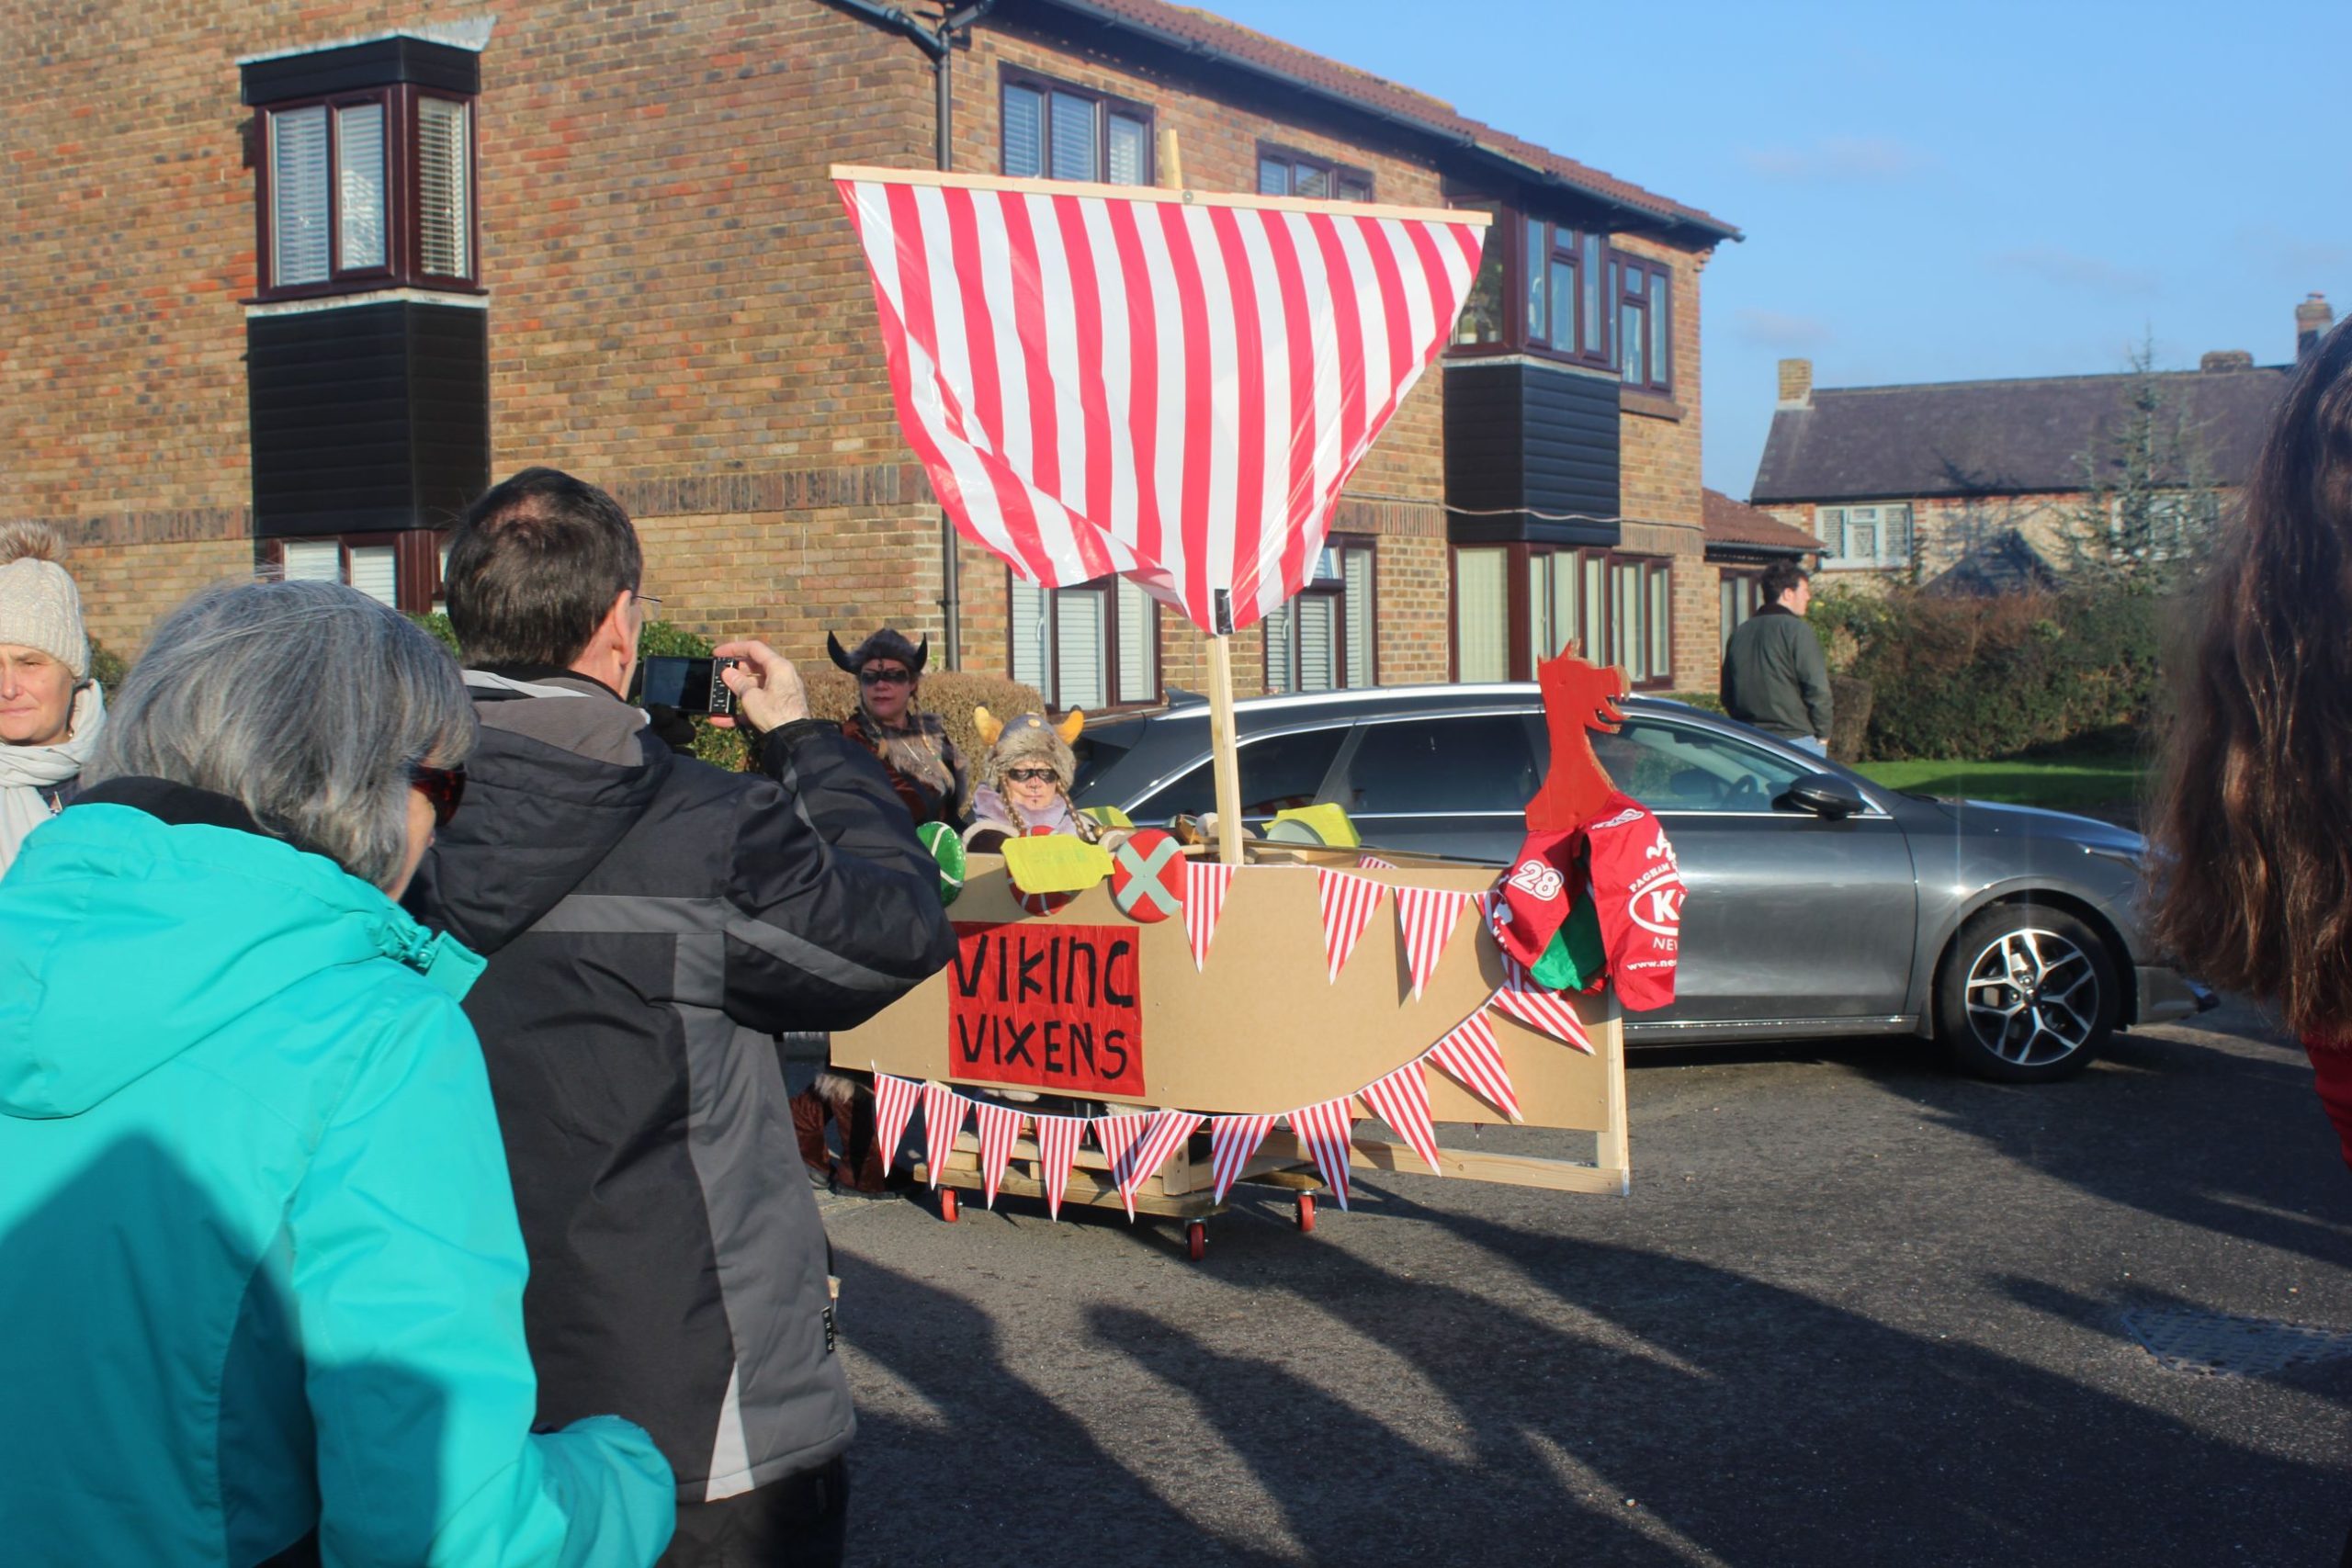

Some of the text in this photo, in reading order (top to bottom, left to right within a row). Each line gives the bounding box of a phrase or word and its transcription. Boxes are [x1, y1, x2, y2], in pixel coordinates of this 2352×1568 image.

[1509, 860, 1564, 901] 28
[1627, 959, 1677, 971] www.ne
[956, 1013, 1127, 1080] VIXENS
